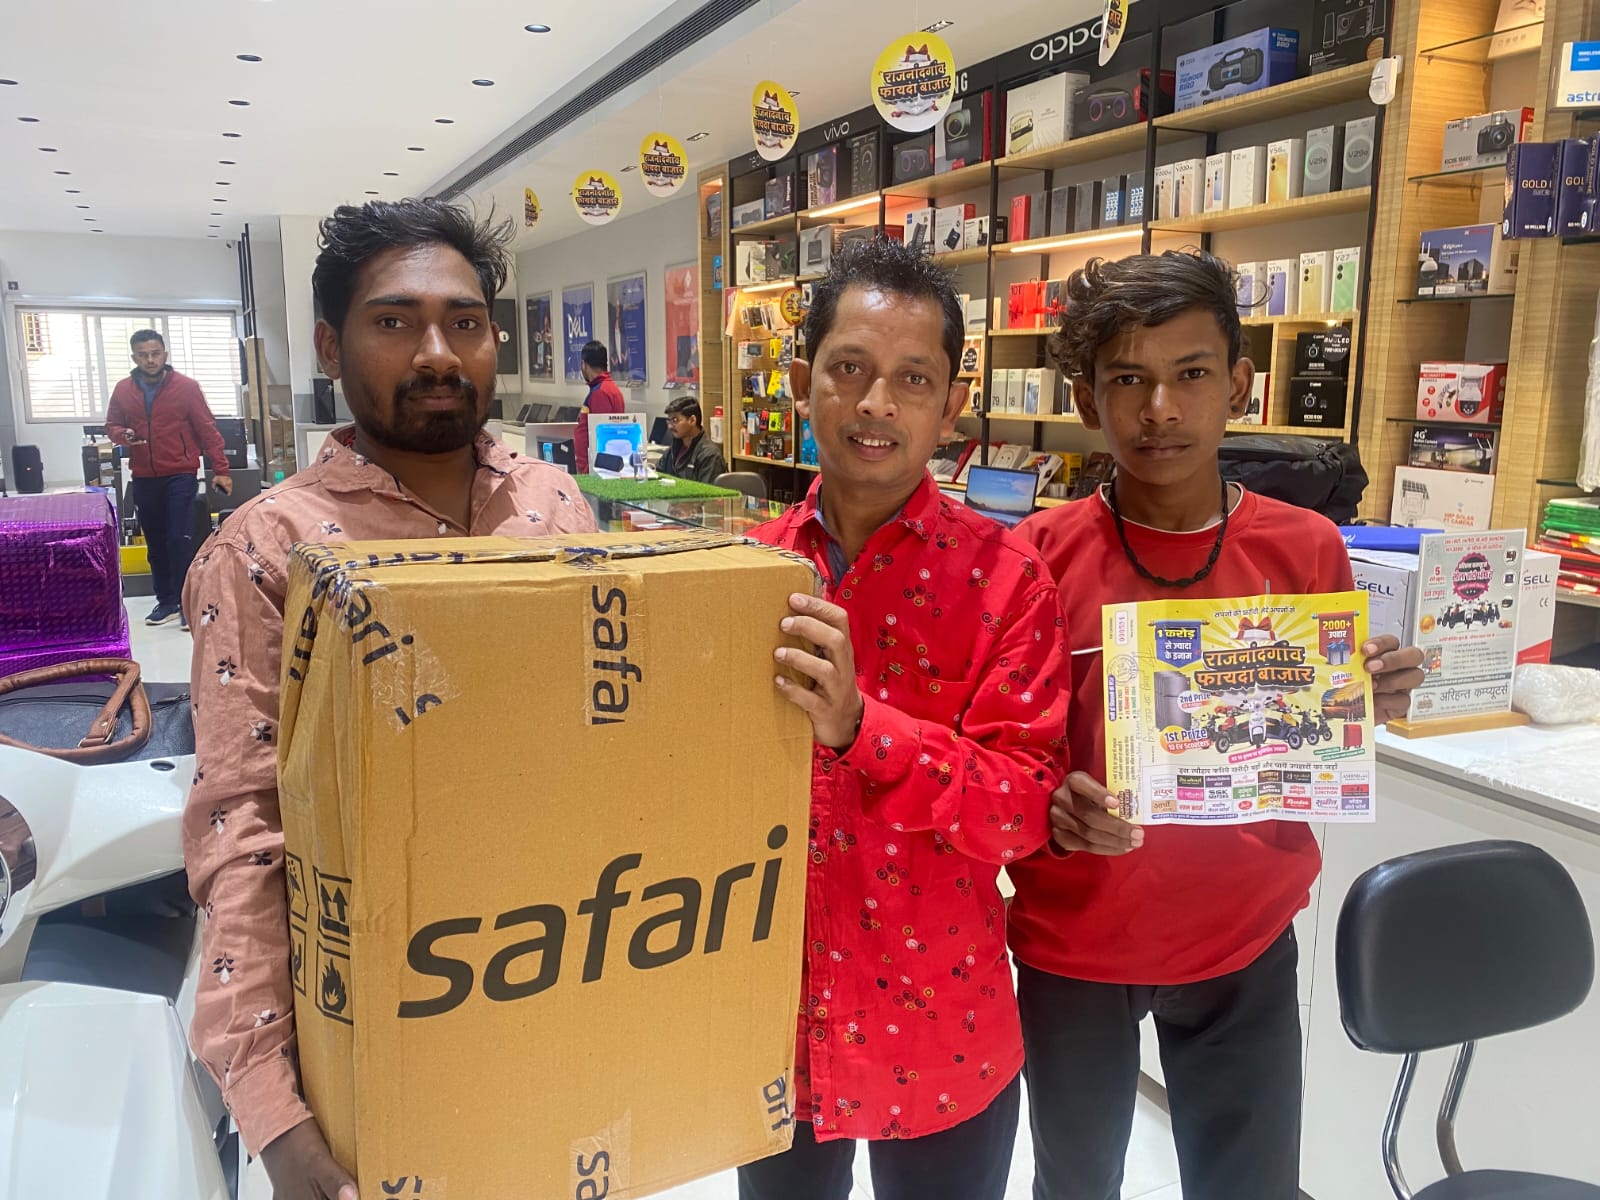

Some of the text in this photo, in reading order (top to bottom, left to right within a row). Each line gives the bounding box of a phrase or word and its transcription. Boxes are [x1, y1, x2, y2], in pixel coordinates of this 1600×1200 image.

[1030, 20, 1103, 61] oppo
[1567, 91, 1600, 102] astr
[823, 121, 850, 141] vivo
[1521, 179, 1547, 190] GOLD
[1565, 176, 1585, 187] GOL
[567, 313, 588, 338] DELL
[1414, 430, 1426, 439] 4G
[1524, 574, 1551, 586] SELL
[1356, 580, 1394, 596] SELL
[1322, 619, 1352, 631] 2000+
[1328, 630, 1347, 639] उपहार
[1196, 669, 1255, 687] फायदा
[1179, 692, 1211, 703] 2nd Prize
[1440, 688, 1471, 702] अरिहन्त
[1165, 729, 1208, 743] 1st Prize
[1185, 740, 1211, 749] Scooters
[397, 824, 789, 1019] safari
